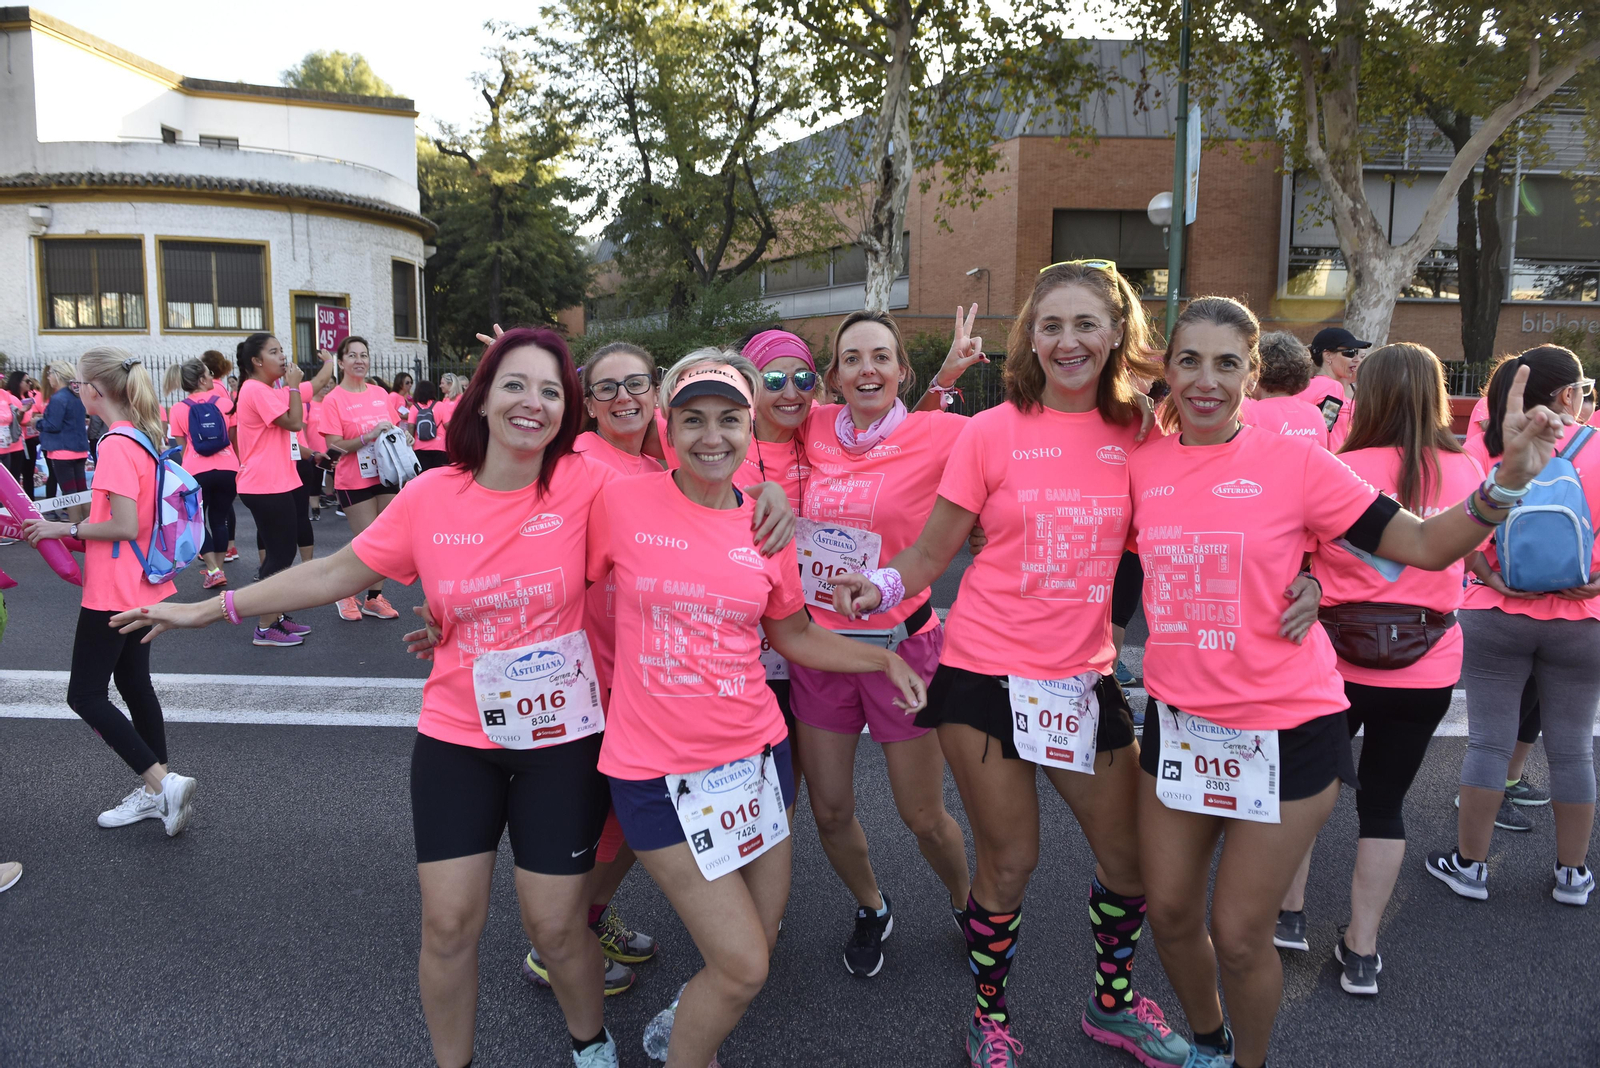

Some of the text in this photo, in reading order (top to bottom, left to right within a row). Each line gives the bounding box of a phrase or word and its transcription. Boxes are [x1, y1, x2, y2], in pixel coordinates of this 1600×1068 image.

[320, 310, 334, 324] SUB
[320, 330, 336, 349] 45'
[814, 441, 842, 456] OYSHO
[1012, 447, 1062, 460] OYSHO
[847, 480, 872, 488] GASTEIZ
[1018, 489, 1080, 502] HOY GANAN
[824, 508, 837, 518] LAS
[1057, 508, 1086, 516] VITORIA
[1094, 507, 1122, 516] GASTEIZ
[523, 519, 560, 533] ASTURIANA
[1073, 517, 1103, 525] MADRID
[432, 533, 484, 545] OYSHO
[1148, 526, 1182, 540] GANAN
[634, 532, 688, 550] OYSHO
[816, 534, 853, 550] ASTURIANA
[1057, 542, 1068, 550] LEN
[1074, 548, 1089, 559] LAS
[1154, 545, 1185, 554] VITORIA
[1193, 544, 1228, 554] GASTEIZ
[1172, 554, 1204, 564] MADRID
[1022, 562, 1060, 572] BARCELONA
[1076, 561, 1118, 577] CHICA
[438, 574, 502, 594] HOY GANAN
[1051, 578, 1076, 588] CORUÑA
[1158, 574, 1166, 582] VA
[636, 576, 705, 598] HOY GANAN
[1159, 582, 1171, 591] LEN
[474, 593, 509, 607] VITORIA
[517, 583, 552, 598] GASTEIZ
[1087, 584, 1111, 603] 201
[1160, 592, 1170, 600] CIA
[1176, 589, 1194, 600] LAS
[495, 597, 530, 609] MADRID
[674, 602, 707, 613] VITORIA
[715, 608, 748, 621] GASTEIZ
[1184, 603, 1236, 623] CHICAS
[691, 613, 723, 624] MADRID
[483, 626, 496, 634] LEN
[675, 627, 683, 636] VA
[1160, 621, 1188, 632] CORUÑA
[484, 634, 494, 642] CIA
[674, 636, 687, 645] LEN
[1198, 629, 1236, 650] 2019
[675, 645, 686, 654] CIA
[694, 644, 710, 655] LAS
[639, 654, 680, 666] BARCELONA
[510, 659, 562, 678] ASTURIANA
[549, 672, 571, 683] Carrera
[674, 674, 702, 684] CORUÑA
[717, 675, 746, 697] 2019
[1042, 680, 1082, 694] ASTURIANA
[517, 690, 566, 716] 016
[532, 714, 556, 726] 8304
[1039, 710, 1079, 733] 016
[577, 723, 597, 732] ZURICH
[1190, 720, 1238, 736] ASTURIANA
[492, 734, 520, 742] OYSHO
[1048, 734, 1068, 746] 7405
[1018, 742, 1038, 753] OYSHO
[1223, 742, 1247, 750] Carrera
[1195, 755, 1241, 778] 016
[707, 767, 752, 790] ASTURIANA
[1206, 780, 1230, 792] 8303
[1163, 791, 1192, 802] OYSHO
[720, 798, 760, 831] 016
[736, 824, 756, 840] 7426
[770, 829, 784, 840] ZURICH
[705, 854, 730, 871] OYSHO
